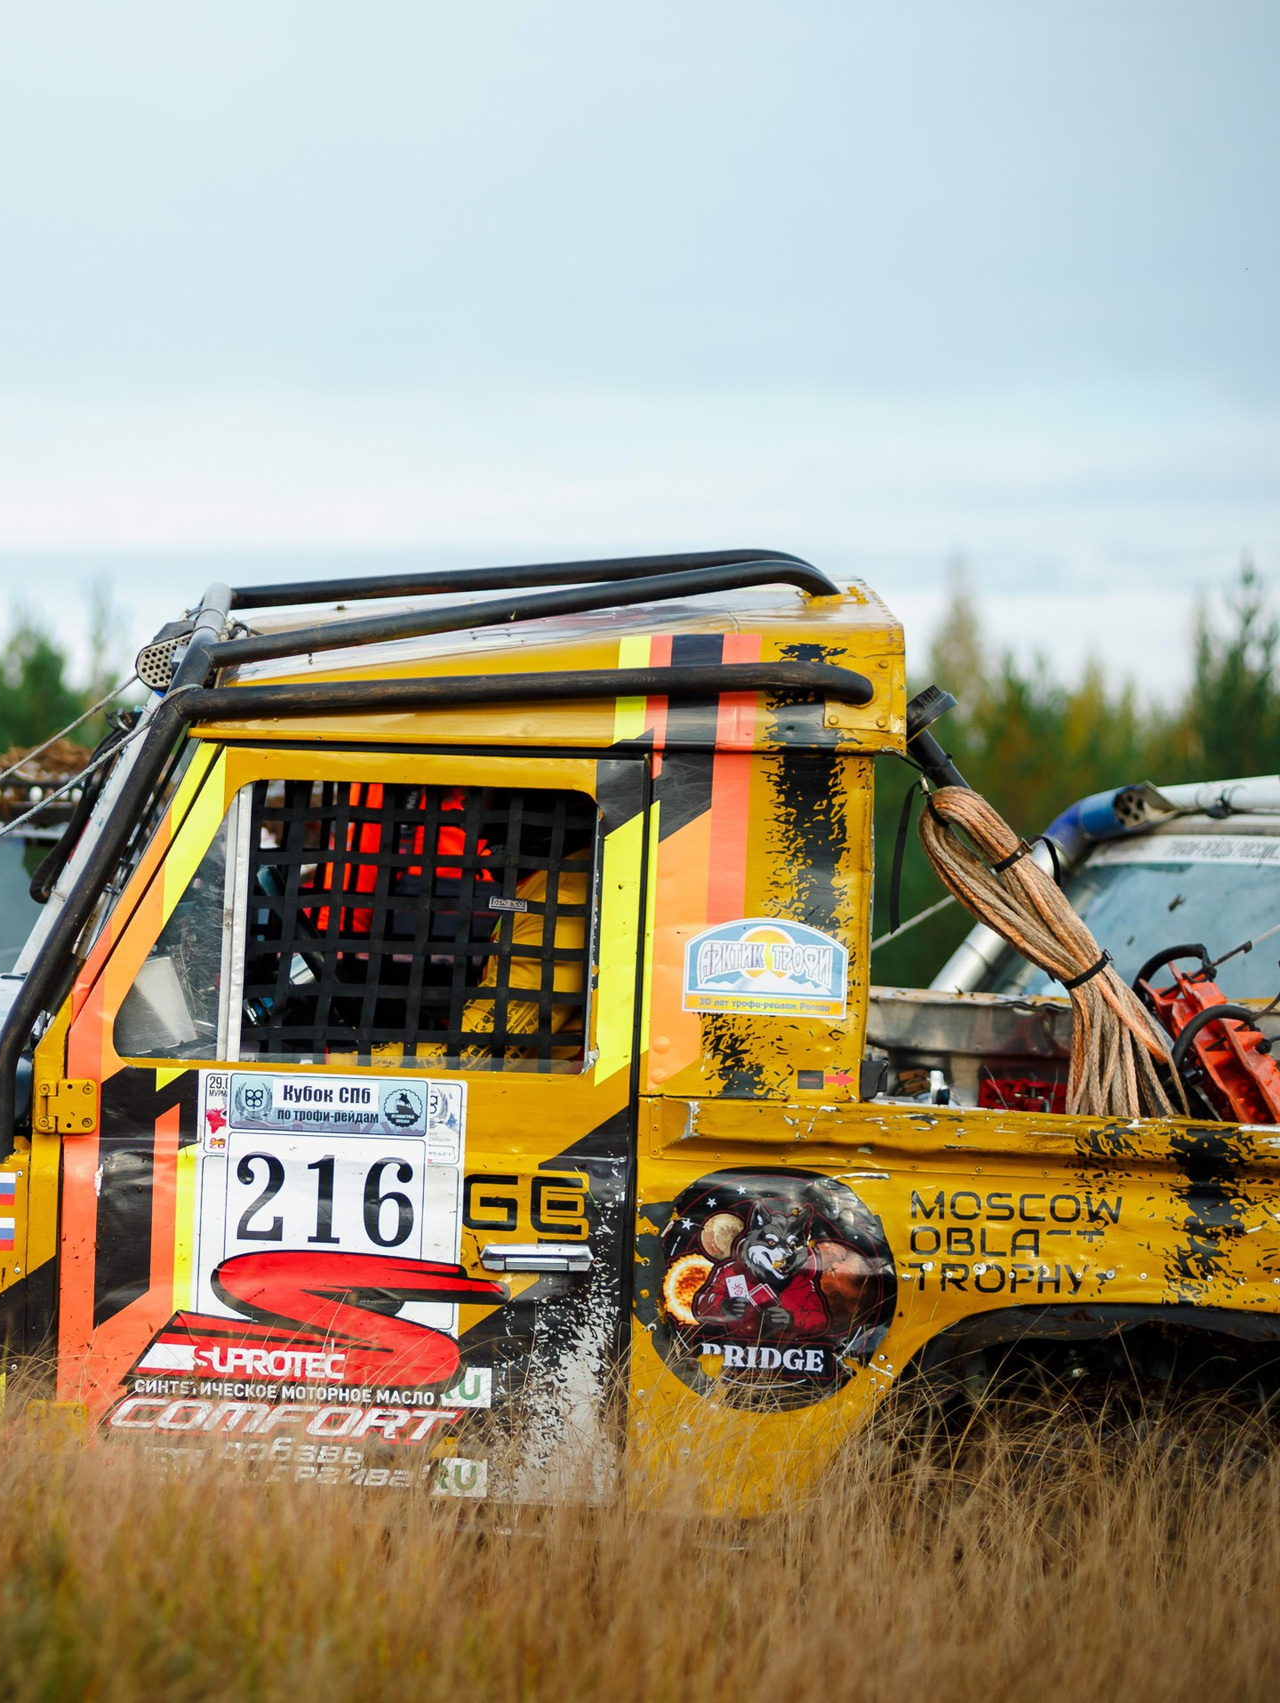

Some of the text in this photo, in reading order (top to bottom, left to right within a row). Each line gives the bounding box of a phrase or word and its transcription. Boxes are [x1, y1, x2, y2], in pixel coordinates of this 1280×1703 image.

[700, 941, 832, 987] АРКТИК ТРОФИ
[283, 1084, 371, 1104] Кубок СПб
[277, 1109, 379, 1124] по трофи-рейдам
[236, 1150, 414, 1248] 216
[911, 1190, 1122, 1225] MOSCOW
[910, 1226, 1105, 1258] OBLA
[908, 1262, 1089, 1295] TROPHY
[194, 1346, 346, 1380] SUPROTEC
[281, 1386, 372, 1403] МОТОРНОЕ
[376, 1389, 435, 1406] МАСЛО
[109, 1398, 459, 1442] COMFORT
